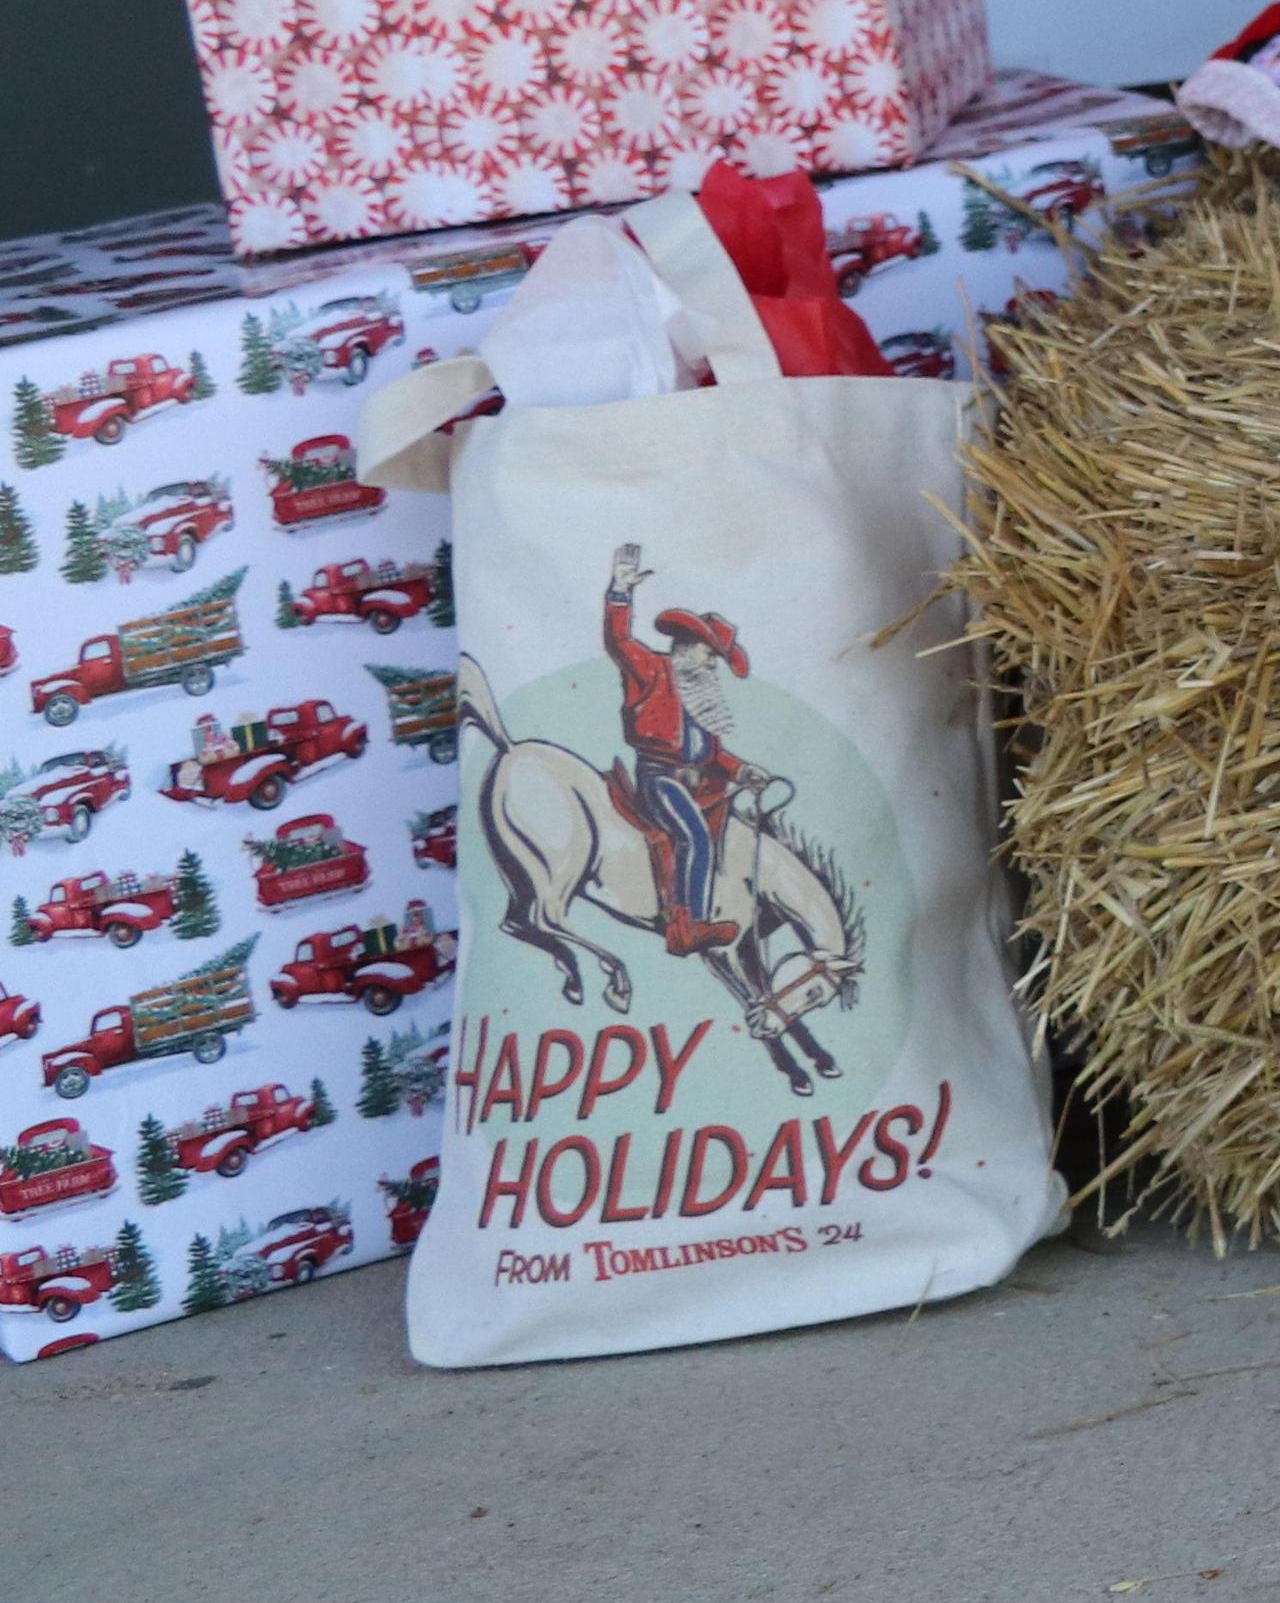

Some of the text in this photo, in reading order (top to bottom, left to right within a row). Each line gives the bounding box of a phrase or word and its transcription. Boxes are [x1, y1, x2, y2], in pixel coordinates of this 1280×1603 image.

[455, 1015, 714, 1135] HAPPY
[21, 1183, 55, 1200] TREE
[478, 1080, 952, 1228] HOLIDAYS!
[495, 1250, 571, 1287] FROM
[584, 1227, 808, 1282] TOMLINSON'S
